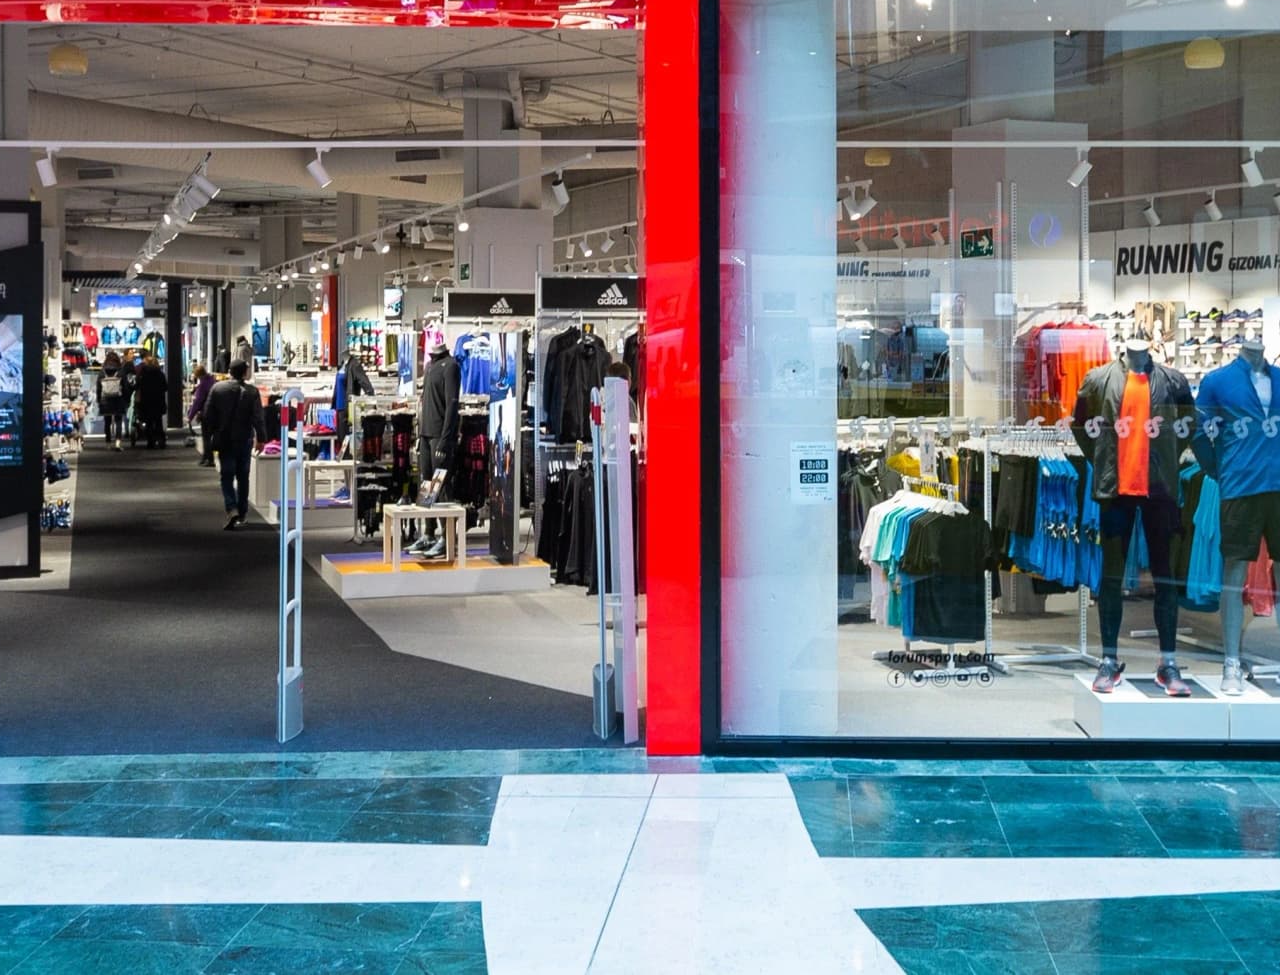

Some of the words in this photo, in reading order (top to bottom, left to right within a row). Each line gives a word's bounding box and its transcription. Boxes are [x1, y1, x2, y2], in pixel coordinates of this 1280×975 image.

[1116, 240, 1224, 276] RUNNING
[1228, 255, 1272, 271] GIZONA
[837, 260, 870, 277] NING
[597, 296, 628, 305] adidas
[887, 649, 995, 666] forumsport.com
